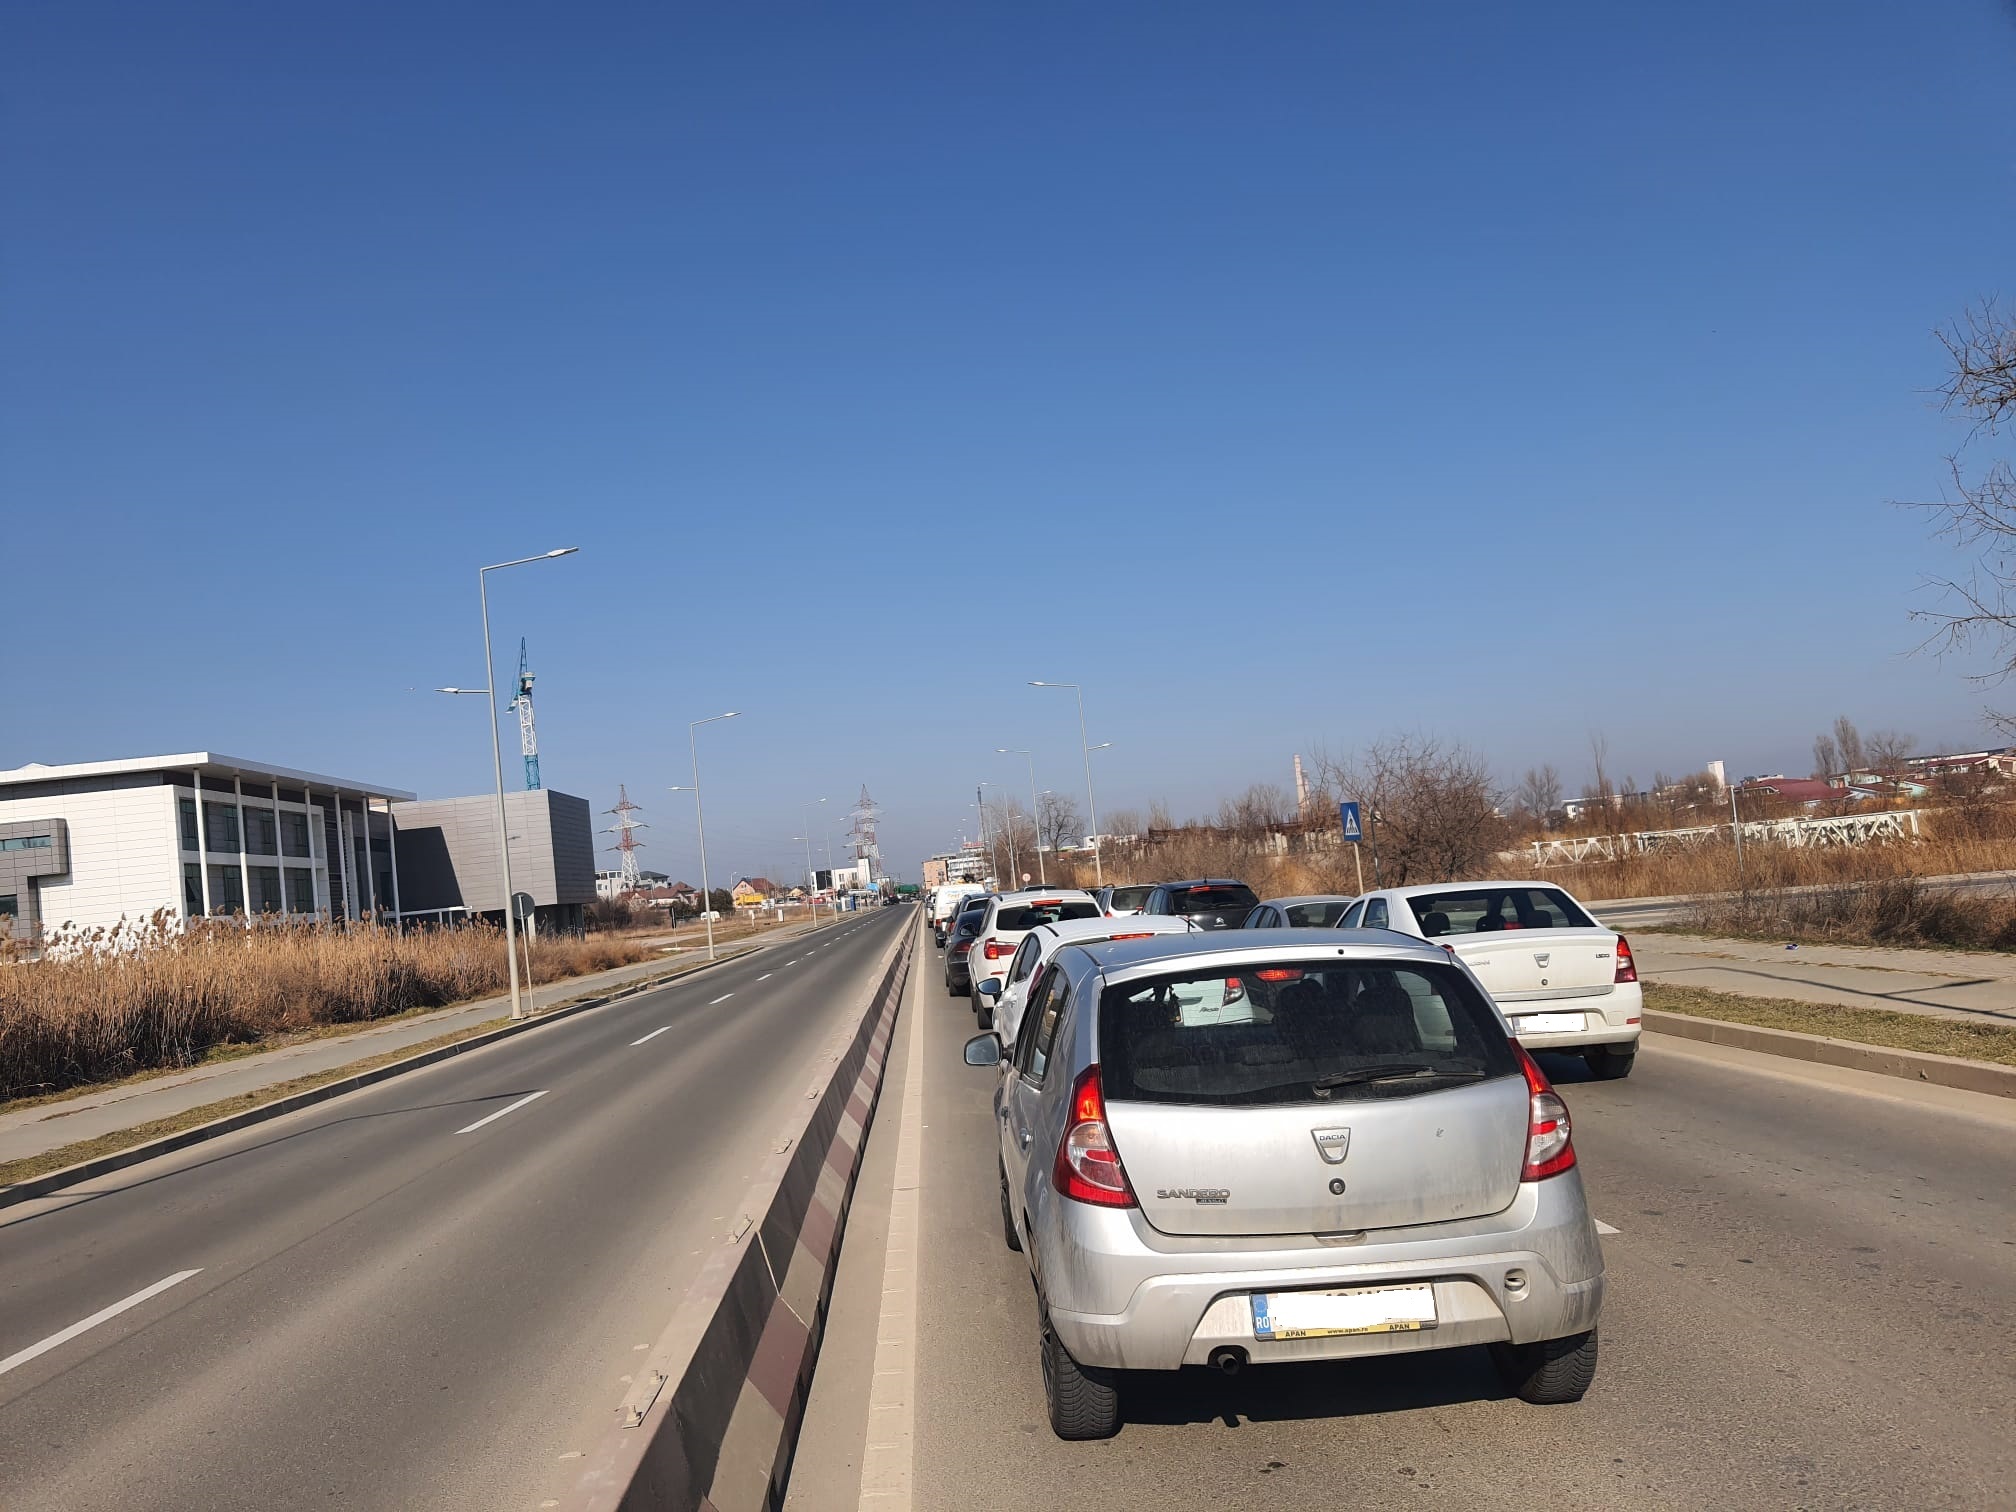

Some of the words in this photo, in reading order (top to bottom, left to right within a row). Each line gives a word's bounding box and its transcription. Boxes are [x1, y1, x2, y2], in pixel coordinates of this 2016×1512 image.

[1157, 1188, 1231, 1199] SANDERO
[1256, 1316, 1270, 1329] RO
[1285, 1330, 1307, 1338] APAN
[1327, 1326, 1369, 1335] www.apan.ro
[1389, 1323, 1410, 1331] APAN
